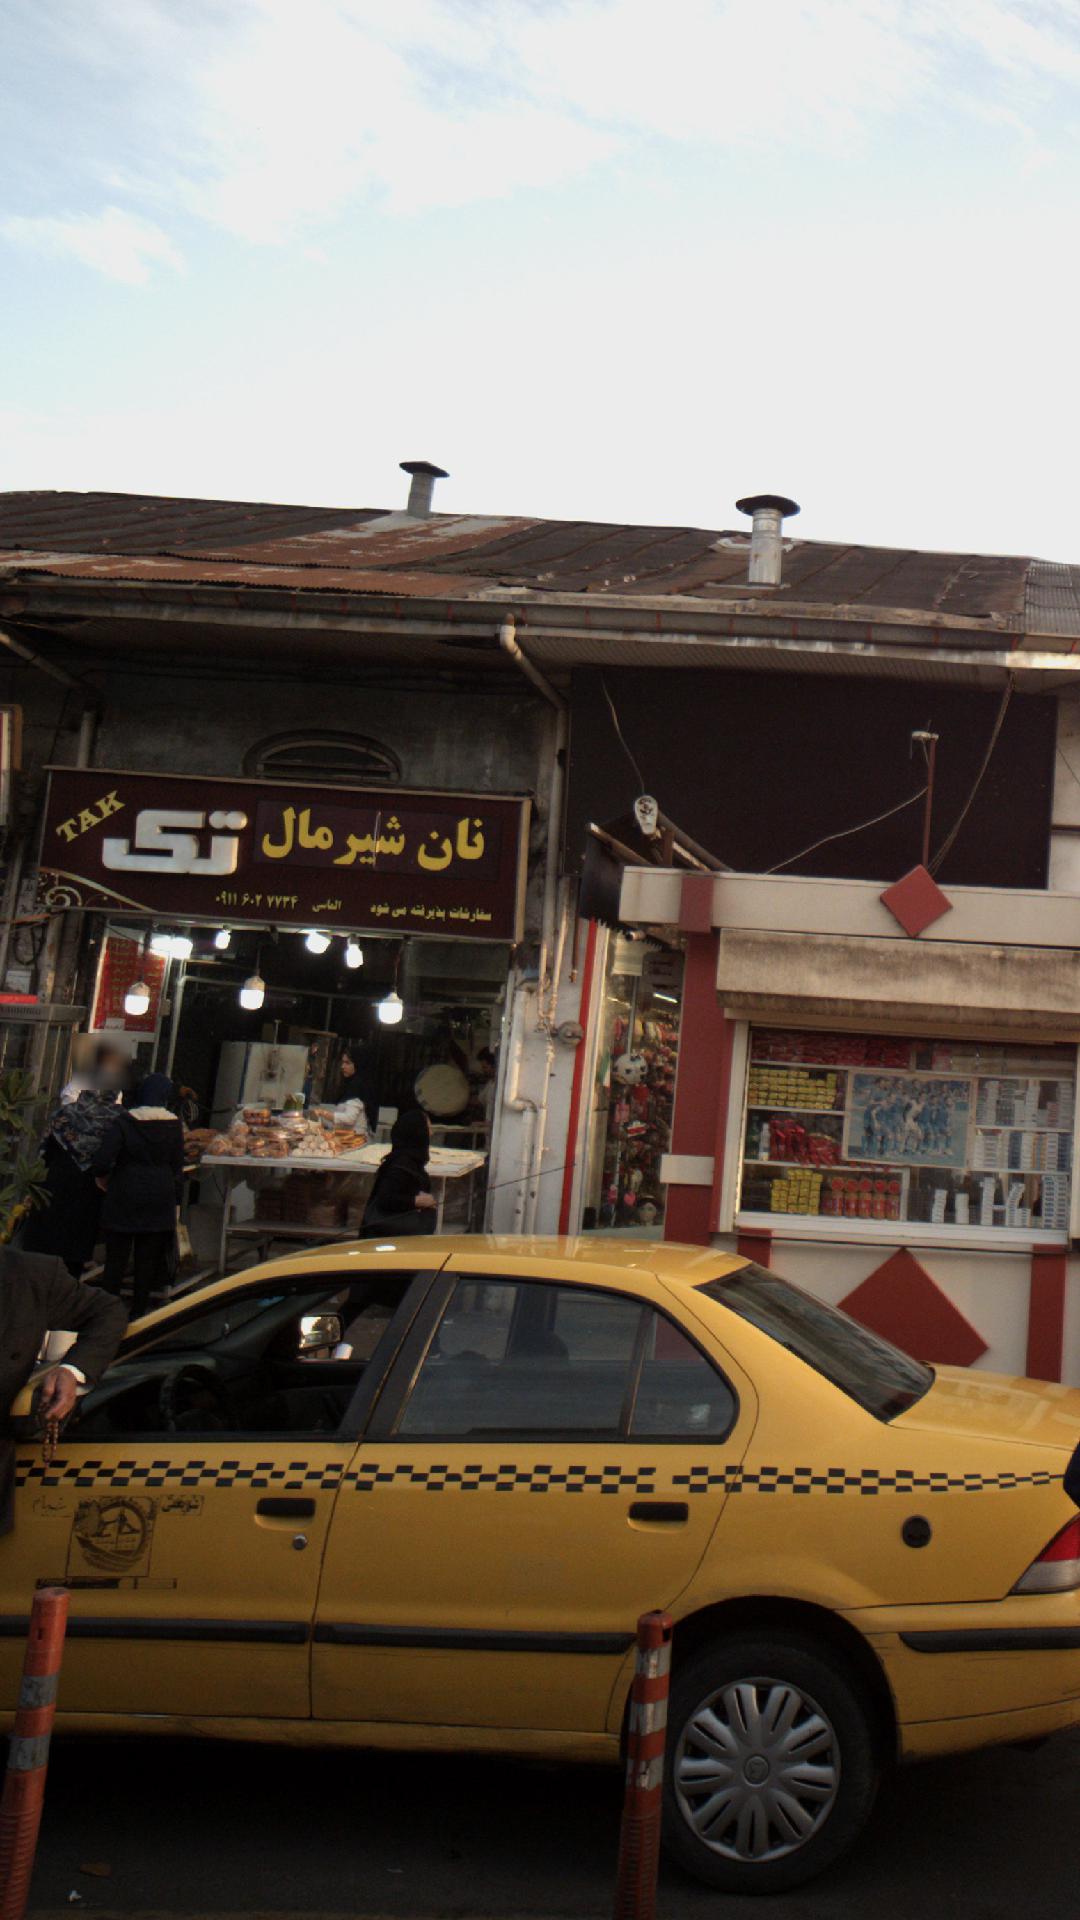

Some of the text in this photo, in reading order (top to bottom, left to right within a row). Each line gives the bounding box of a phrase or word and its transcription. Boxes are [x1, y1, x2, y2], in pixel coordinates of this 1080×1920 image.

[56, 790, 125, 842] TAK
[103, 809, 248, 875] تک
[417, 818, 485, 871] نان
[370, 902, 492, 923] سفارشات پذیرفته می شود
